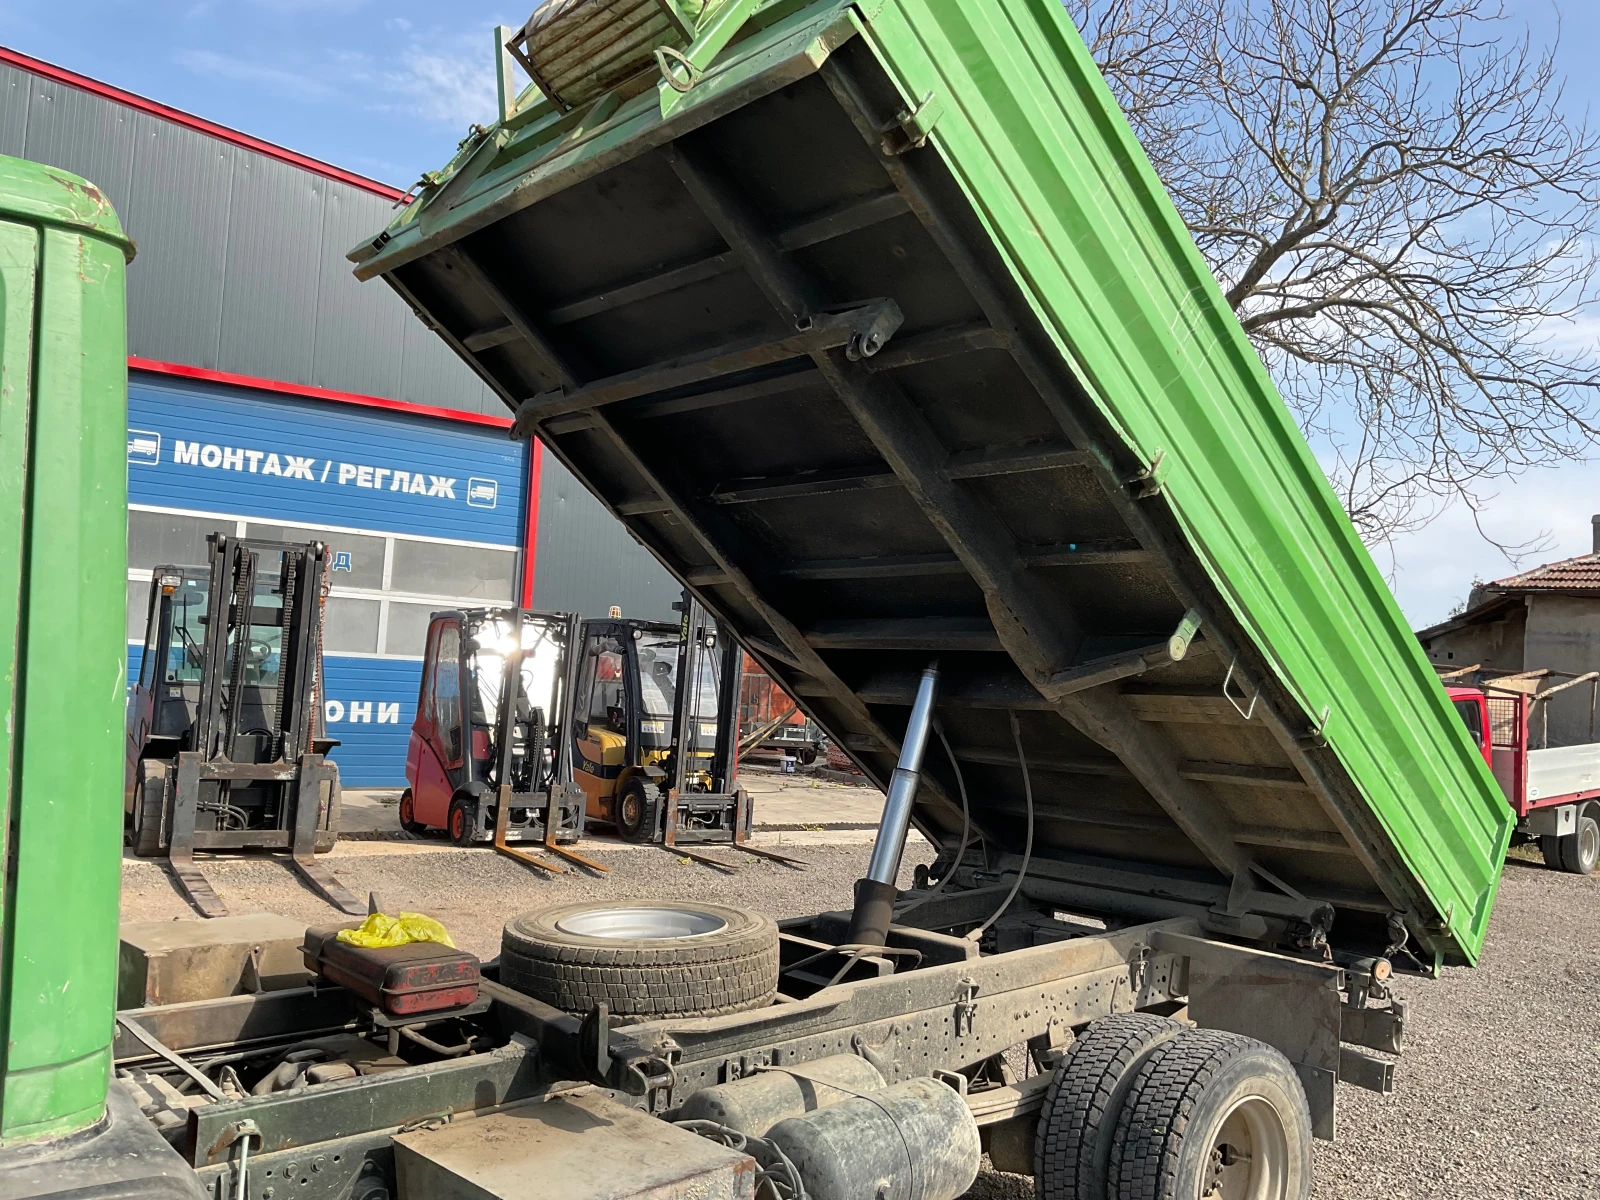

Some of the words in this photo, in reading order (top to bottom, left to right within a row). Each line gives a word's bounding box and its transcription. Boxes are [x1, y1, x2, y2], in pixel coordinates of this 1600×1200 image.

[174, 440, 315, 481] МОНТАЖ
[320, 460, 333, 483] /
[339, 463, 456, 499] РЕГЛАЖ
[681, 614, 689, 641] Yale
[582, 760, 595, 773] Yale
